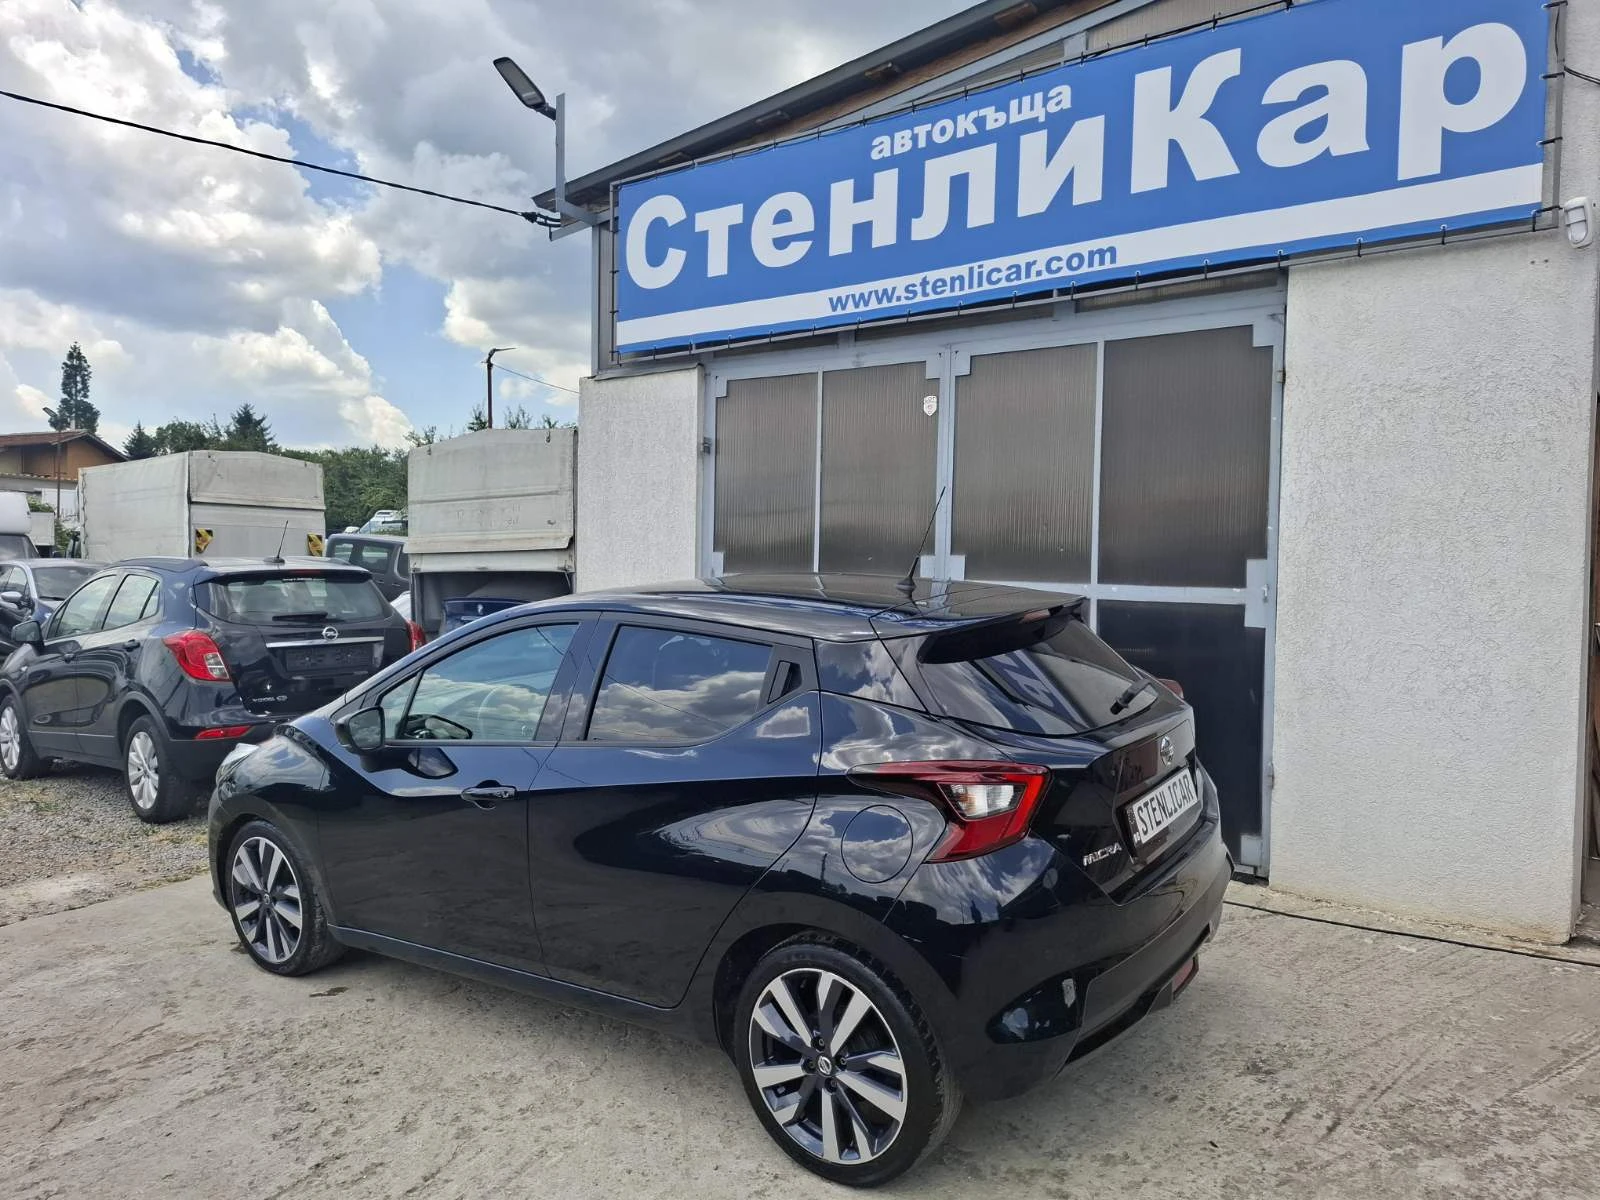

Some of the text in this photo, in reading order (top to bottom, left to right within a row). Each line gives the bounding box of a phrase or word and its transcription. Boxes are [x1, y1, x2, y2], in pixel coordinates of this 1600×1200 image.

[870, 84, 1072, 160] автокъща
[828, 243, 1117, 313] www.stenlicar.com
[1136, 773, 1194, 836] STENLICAR
[1082, 842, 1122, 867] MICRA
